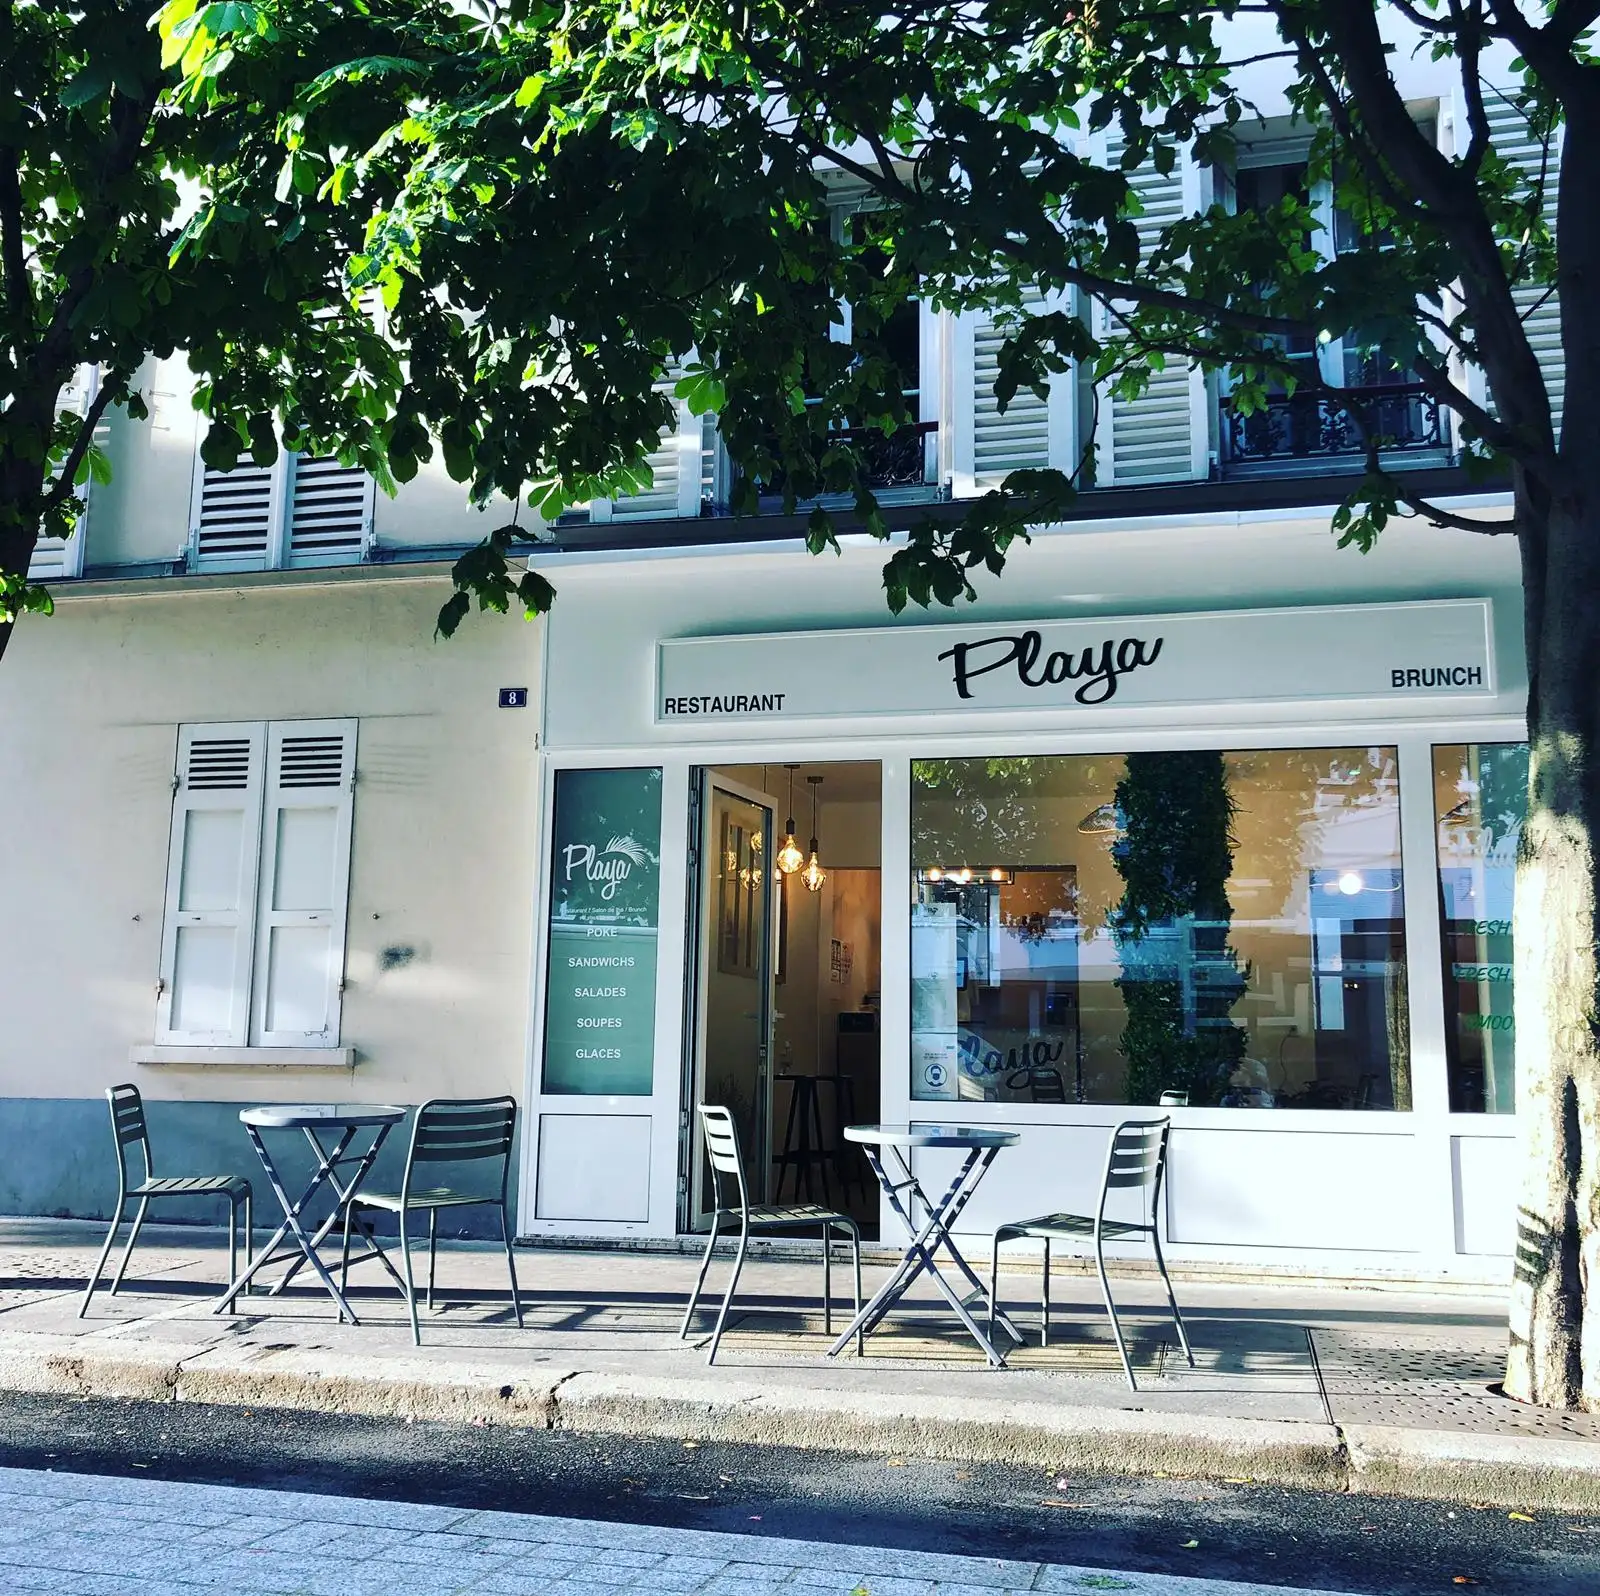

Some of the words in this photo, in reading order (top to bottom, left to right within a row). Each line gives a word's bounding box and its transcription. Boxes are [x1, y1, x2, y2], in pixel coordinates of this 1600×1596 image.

[937, 630, 1164, 705] Playa
[1391, 667, 1483, 688] BRUNCH
[508, 691, 517, 705] 8
[664, 694, 786, 714] RESTAURANT
[562, 844, 632, 900] Playa
[586, 927, 618, 937] POKE
[568, 957, 635, 967] SANDWICHS
[574, 987, 627, 997] SALADES
[576, 1018, 622, 1028] SOUPES
[575, 1048, 622, 1059] GLACES
[957, 1035, 1064, 1090] laya
